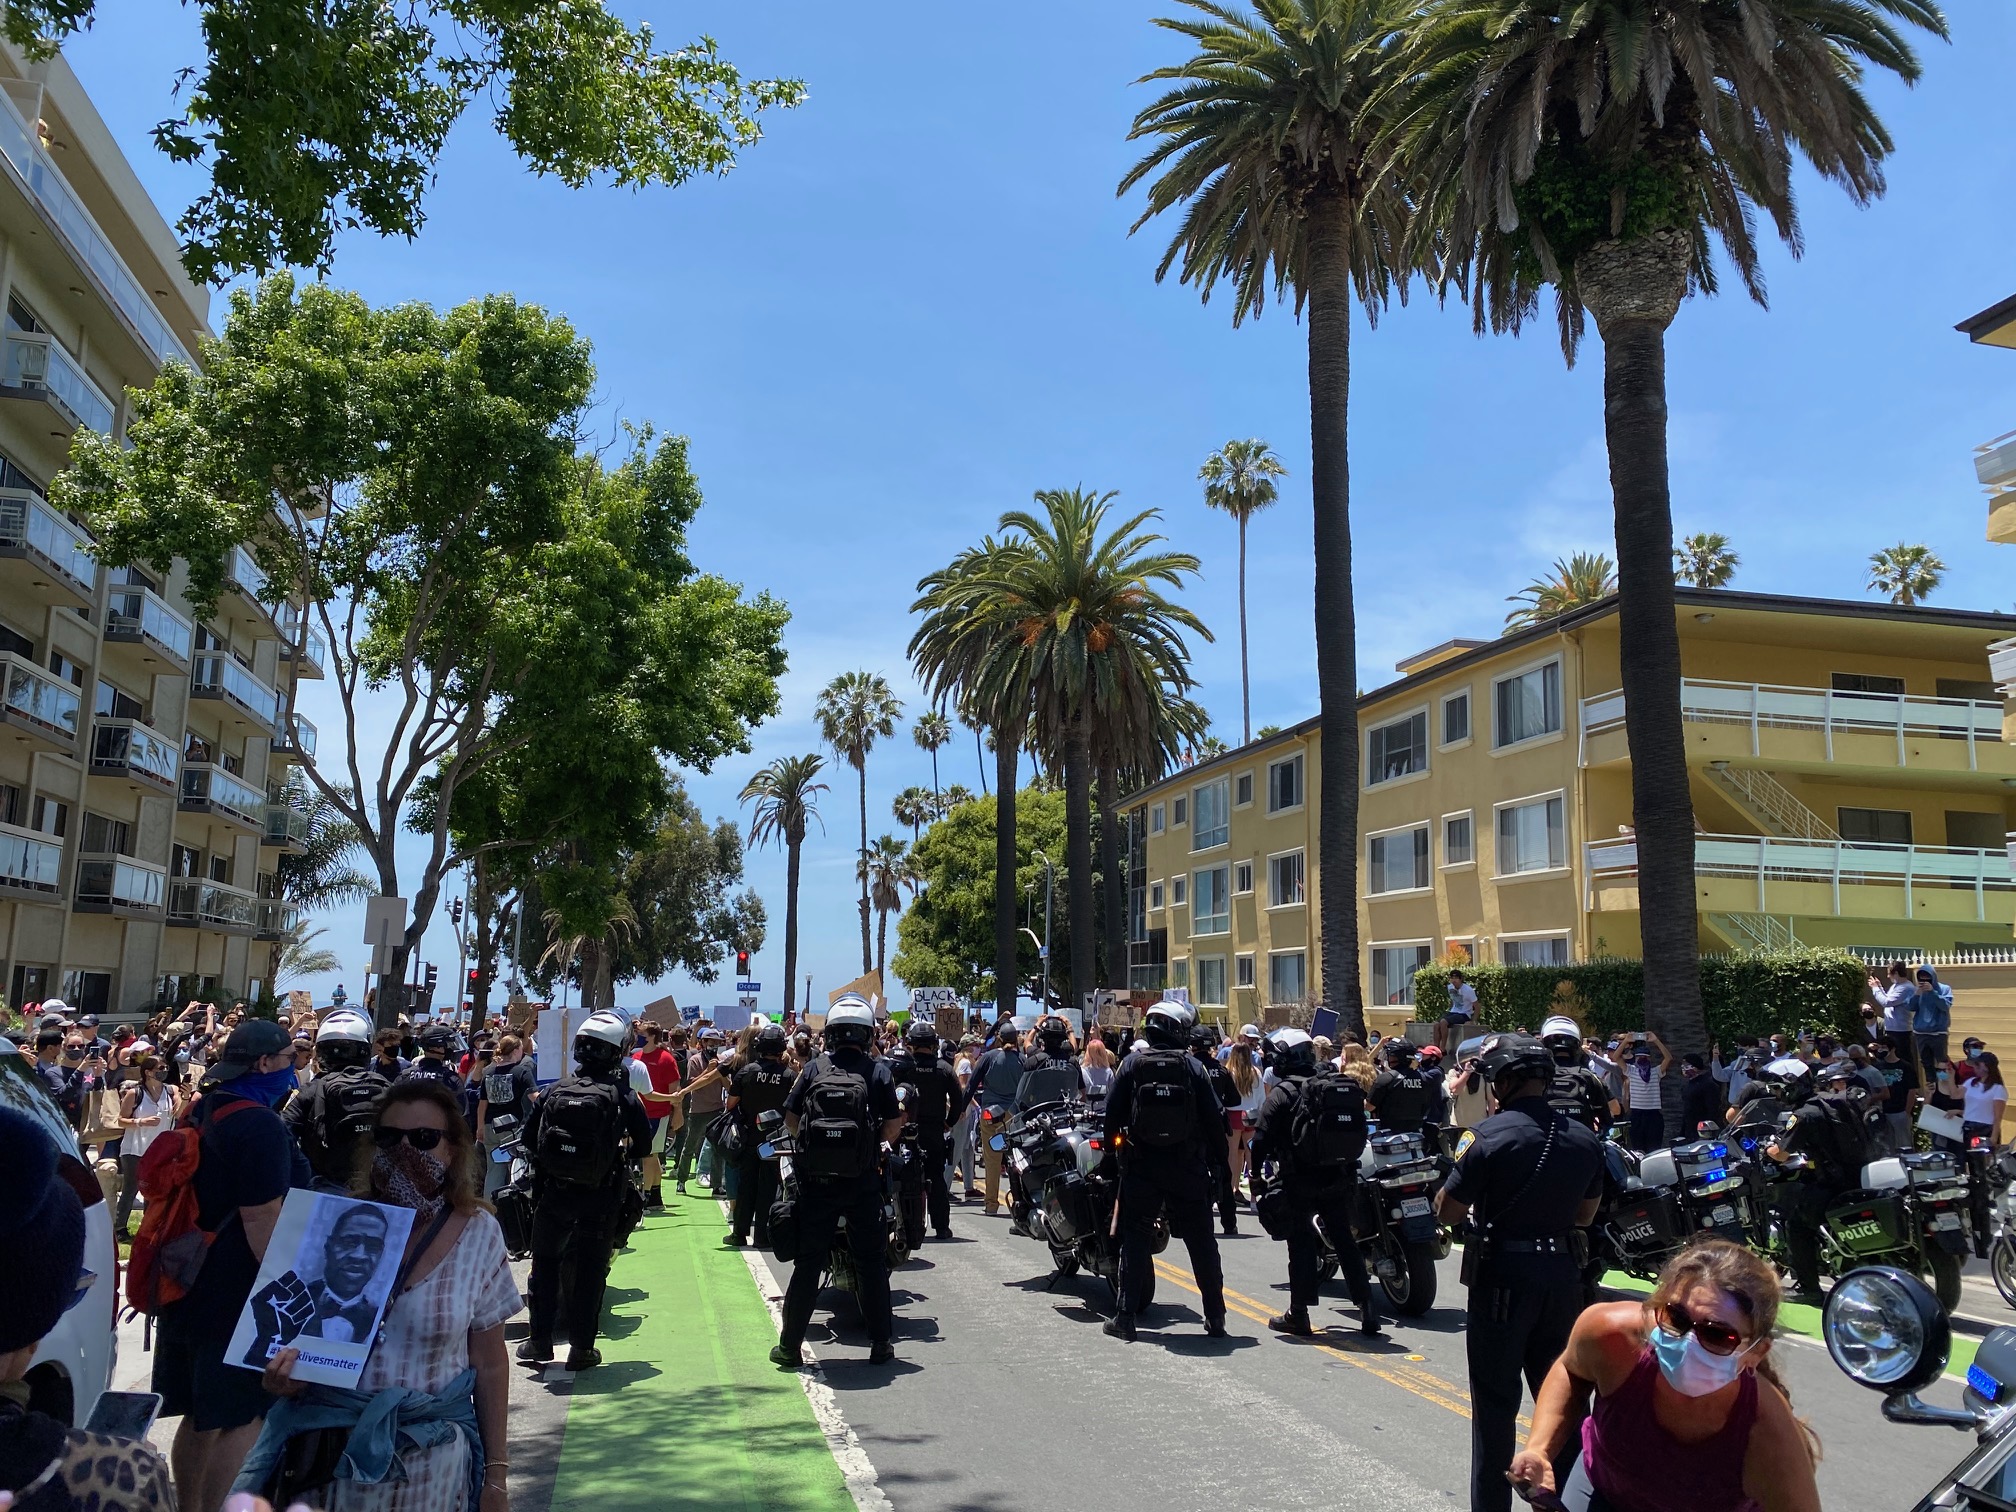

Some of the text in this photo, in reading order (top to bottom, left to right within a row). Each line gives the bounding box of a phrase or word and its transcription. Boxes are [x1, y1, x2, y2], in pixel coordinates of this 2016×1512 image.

[914, 989, 955, 1002] BLACK
[1132, 991, 1146, 999] END
[938, 1011, 962, 1024] FUCK
[1045, 1058, 1068, 1071] POLICE
[756, 1071, 782, 1085] POCE
[1403, 1079, 1423, 1089] POLICE
[1620, 1224, 1656, 1244] POLICE
[1838, 1222, 1881, 1242] POLICE
[270, 1346, 359, 1370] #klivesmatter
